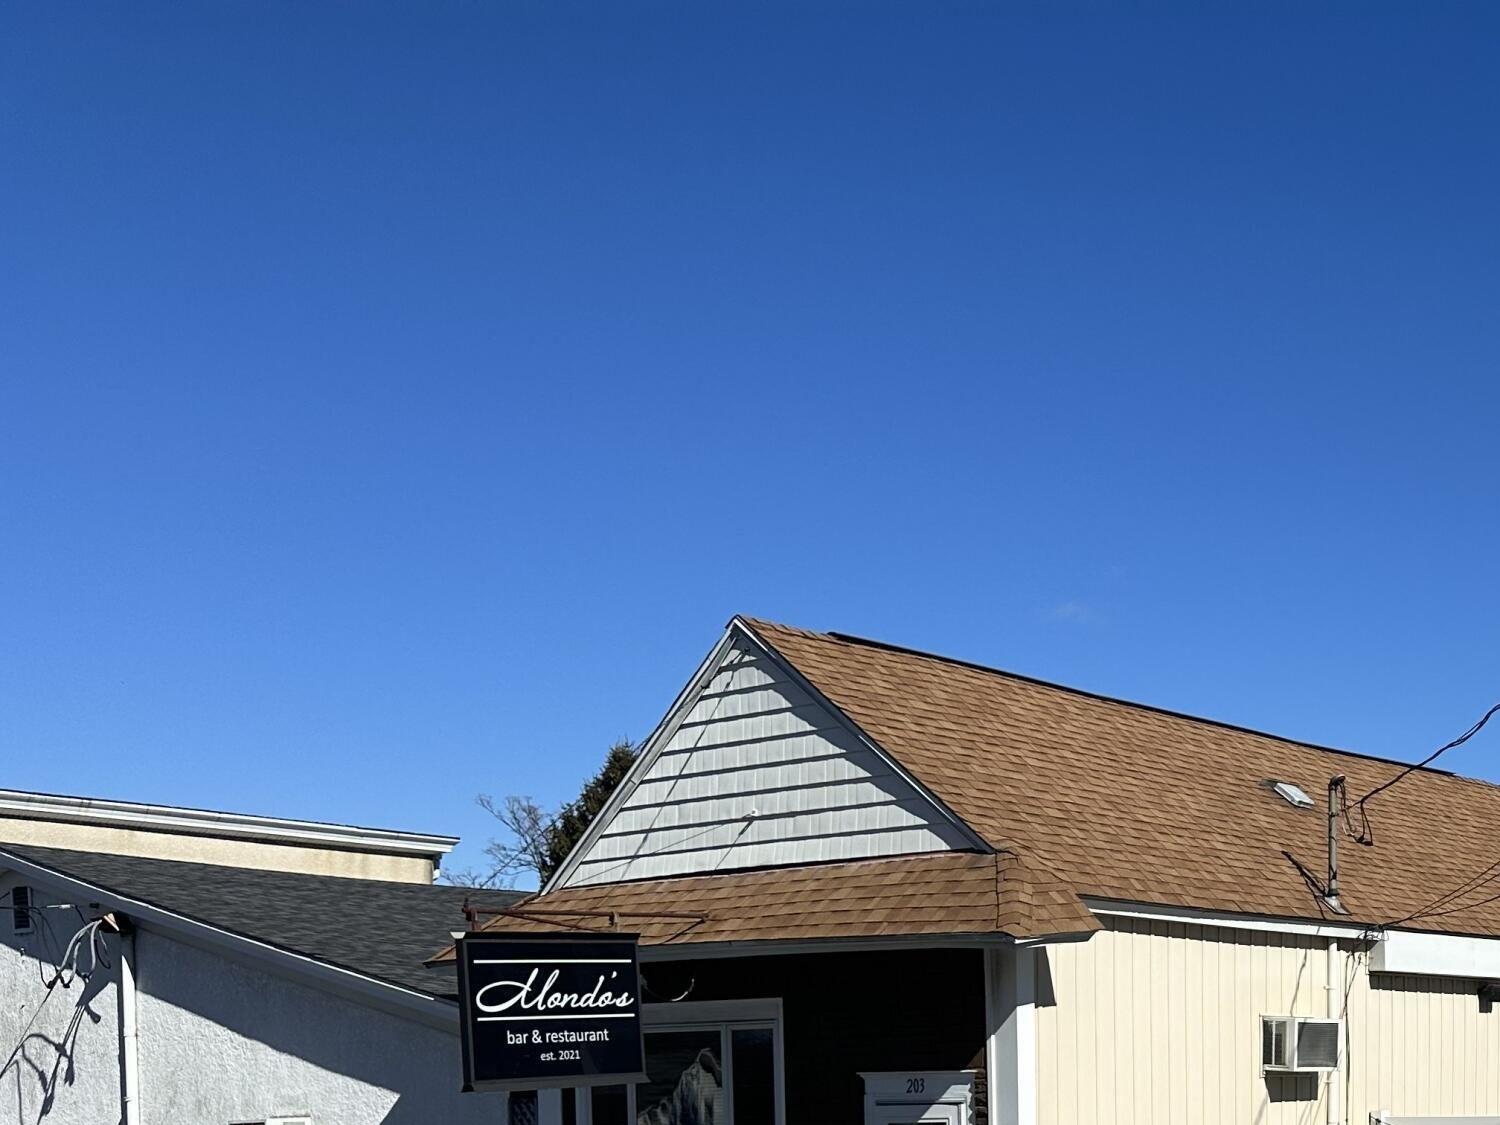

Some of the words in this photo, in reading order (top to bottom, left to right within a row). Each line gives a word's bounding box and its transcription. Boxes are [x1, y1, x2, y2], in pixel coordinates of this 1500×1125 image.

[475, 967, 634, 1013] Mondo's
[507, 1030, 528, 1044] bar
[531, 1030, 543, 1044] &
[546, 1028, 610, 1043] restaurant
[540, 1051, 556, 1060] est.
[559, 1050, 580, 1060] 2021
[906, 1078, 925, 1093] 203
